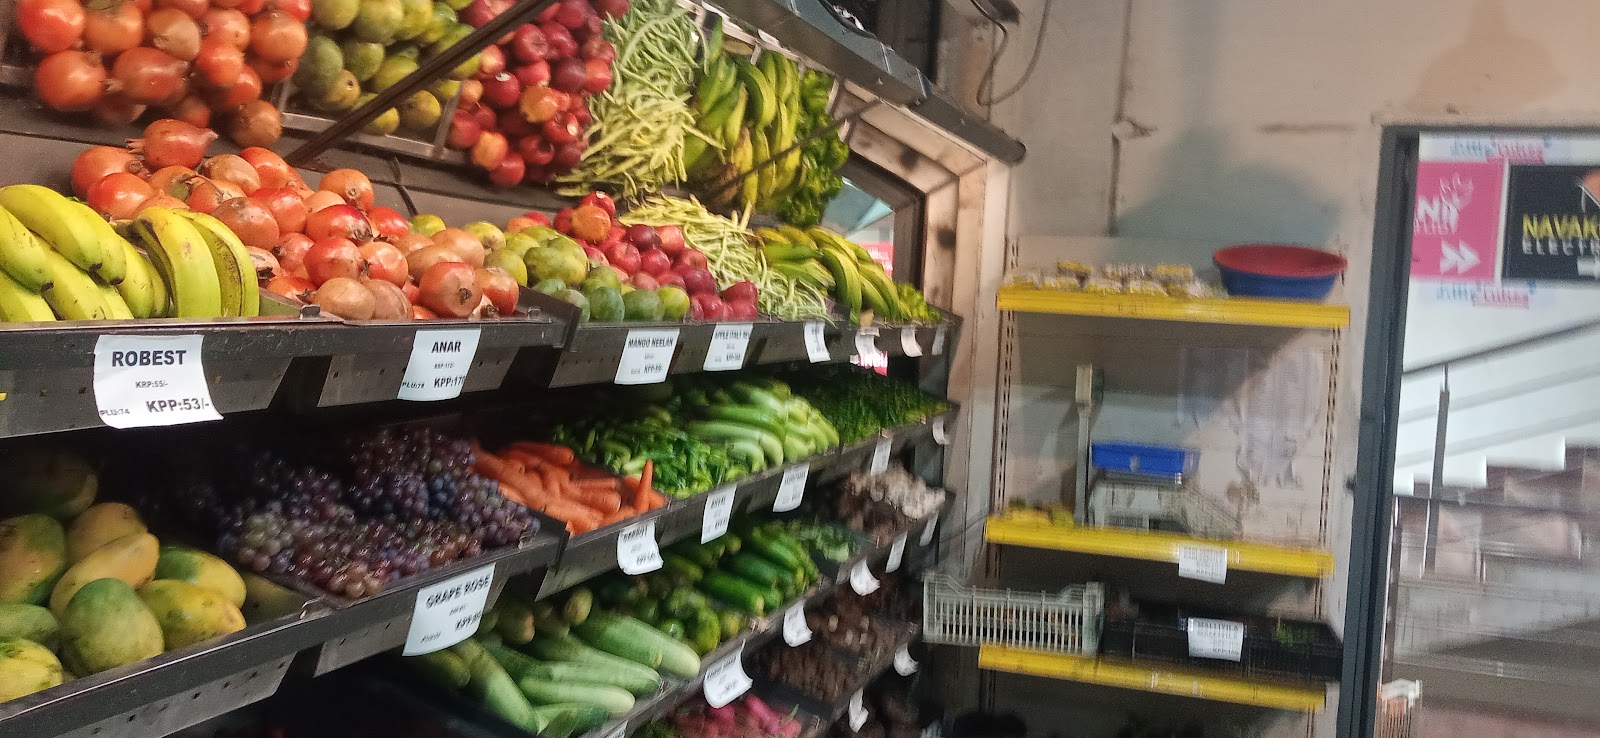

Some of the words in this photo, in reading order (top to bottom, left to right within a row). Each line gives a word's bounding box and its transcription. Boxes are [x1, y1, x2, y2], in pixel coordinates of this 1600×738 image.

[431, 341, 462, 353] ANAR
[628, 337, 651, 349] MANGO
[111, 350, 187, 367] ROBEST
[135, 380, 169, 389] KRP:55/-
[145, 398, 210, 413] KPP:53/-
[99, 408, 131, 416] PLU:74
[426, 584, 463, 609] GRAPE
[463, 573, 491, 596] ROSE
